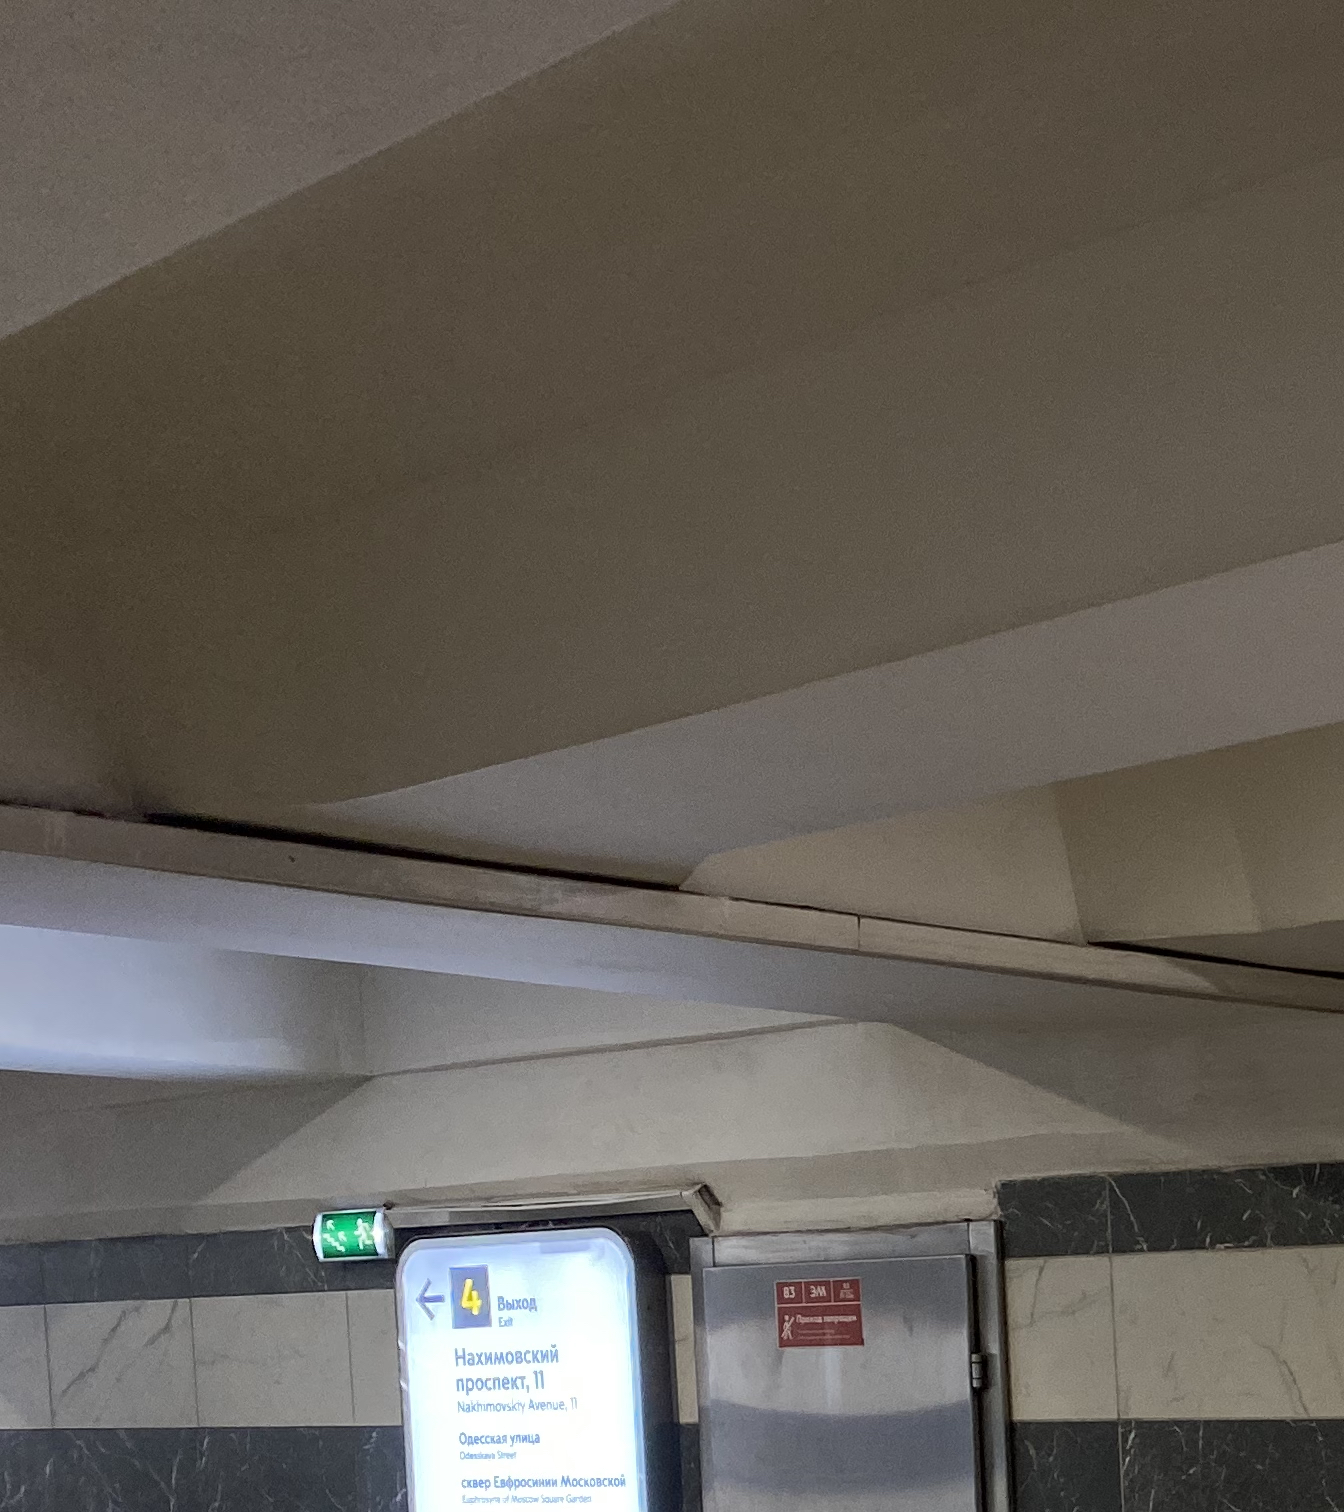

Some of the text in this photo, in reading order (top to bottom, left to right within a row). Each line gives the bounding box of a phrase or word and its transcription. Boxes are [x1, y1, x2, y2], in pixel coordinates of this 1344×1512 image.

[461, 1278, 483, 1316] 4
[497, 1295, 538, 1313] Выход
[498, 1316, 514, 1328] Exit
[454, 1343, 559, 1367] Нахимовский
[456, 1369, 545, 1397] проспект, 11
[528, 1398, 568, 1413] Avenue,
[569, 1396, 578, 1410] 11
[458, 1431, 541, 1447] Одесская улица
[497, 1450, 517, 1460] Street
[461, 1473, 627, 1491] сквер Евфросинии Московской
[511, 1494, 540, 1504] Moscow
